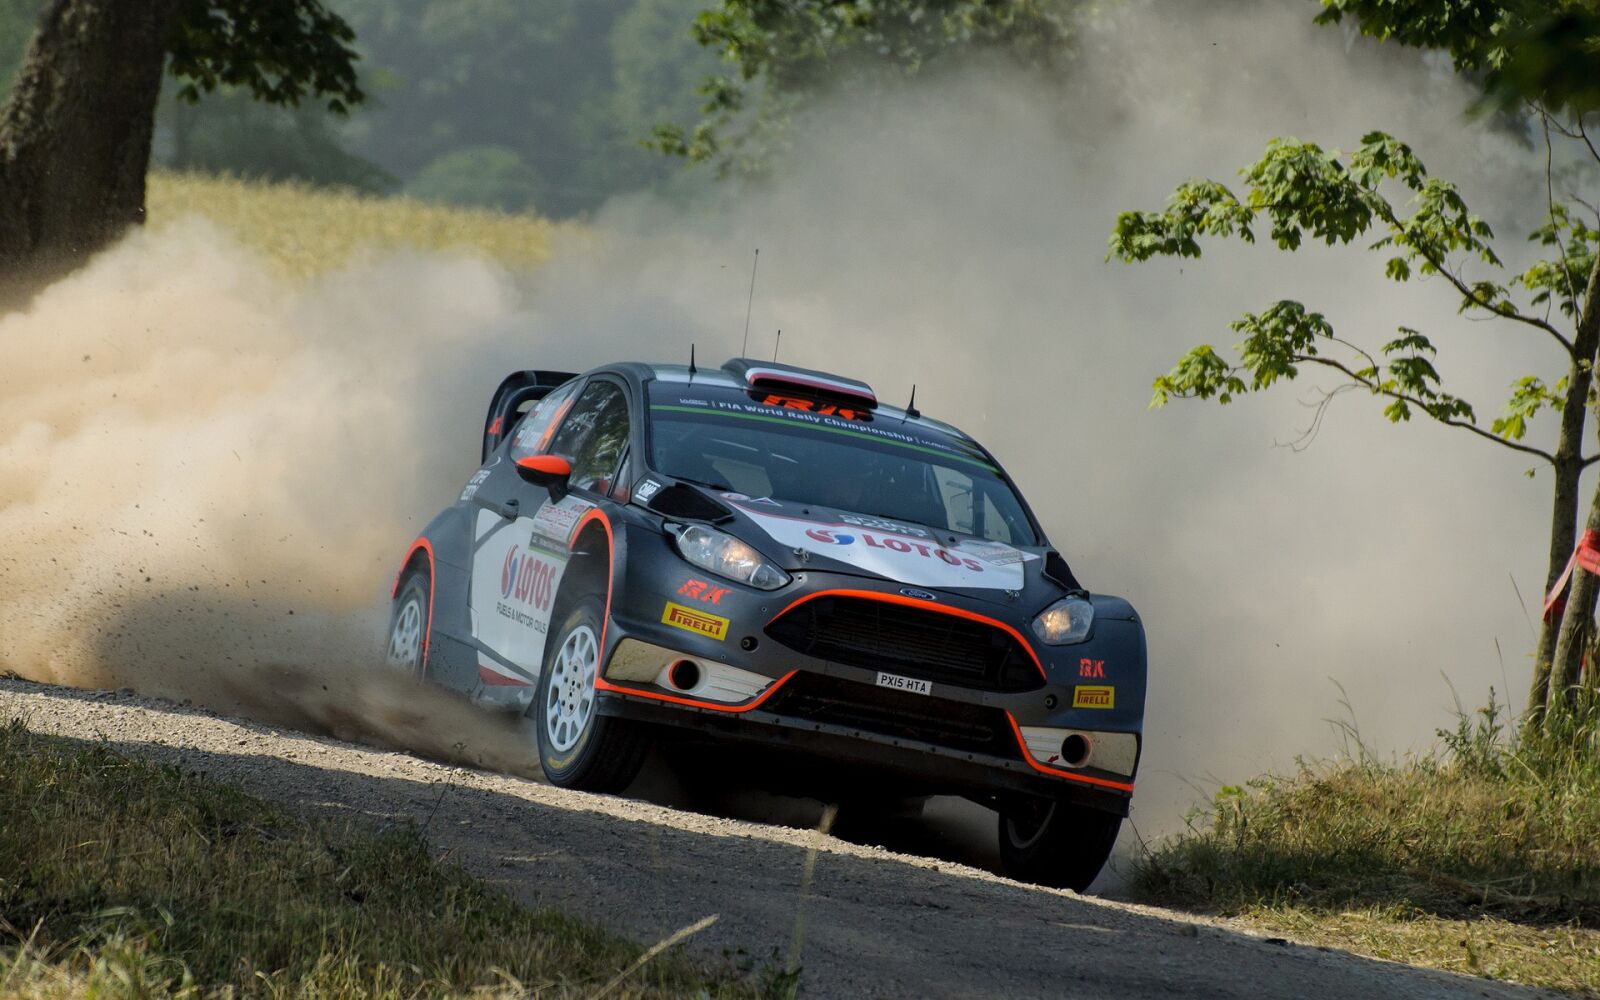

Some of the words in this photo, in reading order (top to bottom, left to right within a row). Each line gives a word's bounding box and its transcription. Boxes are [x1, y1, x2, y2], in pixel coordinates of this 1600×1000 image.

[719, 401, 742, 411] FIA
[744, 404, 784, 417] World
[787, 411, 820, 424] Rally
[824, 417, 914, 443] Championship
[862, 533, 984, 572] LOTOS
[514, 553, 557, 612] LOTOS
[676, 579, 733, 606] RK
[496, 601, 511, 619] FUELS
[516, 610, 534, 629] MOTOR
[534, 619, 547, 635] OILS
[668, 607, 723, 636] PIRELLI
[1079, 658, 1106, 679] RK
[879, 674, 904, 688] PX15
[906, 680, 927, 693] HTA
[1076, 689, 1111, 705] PIRELLI
